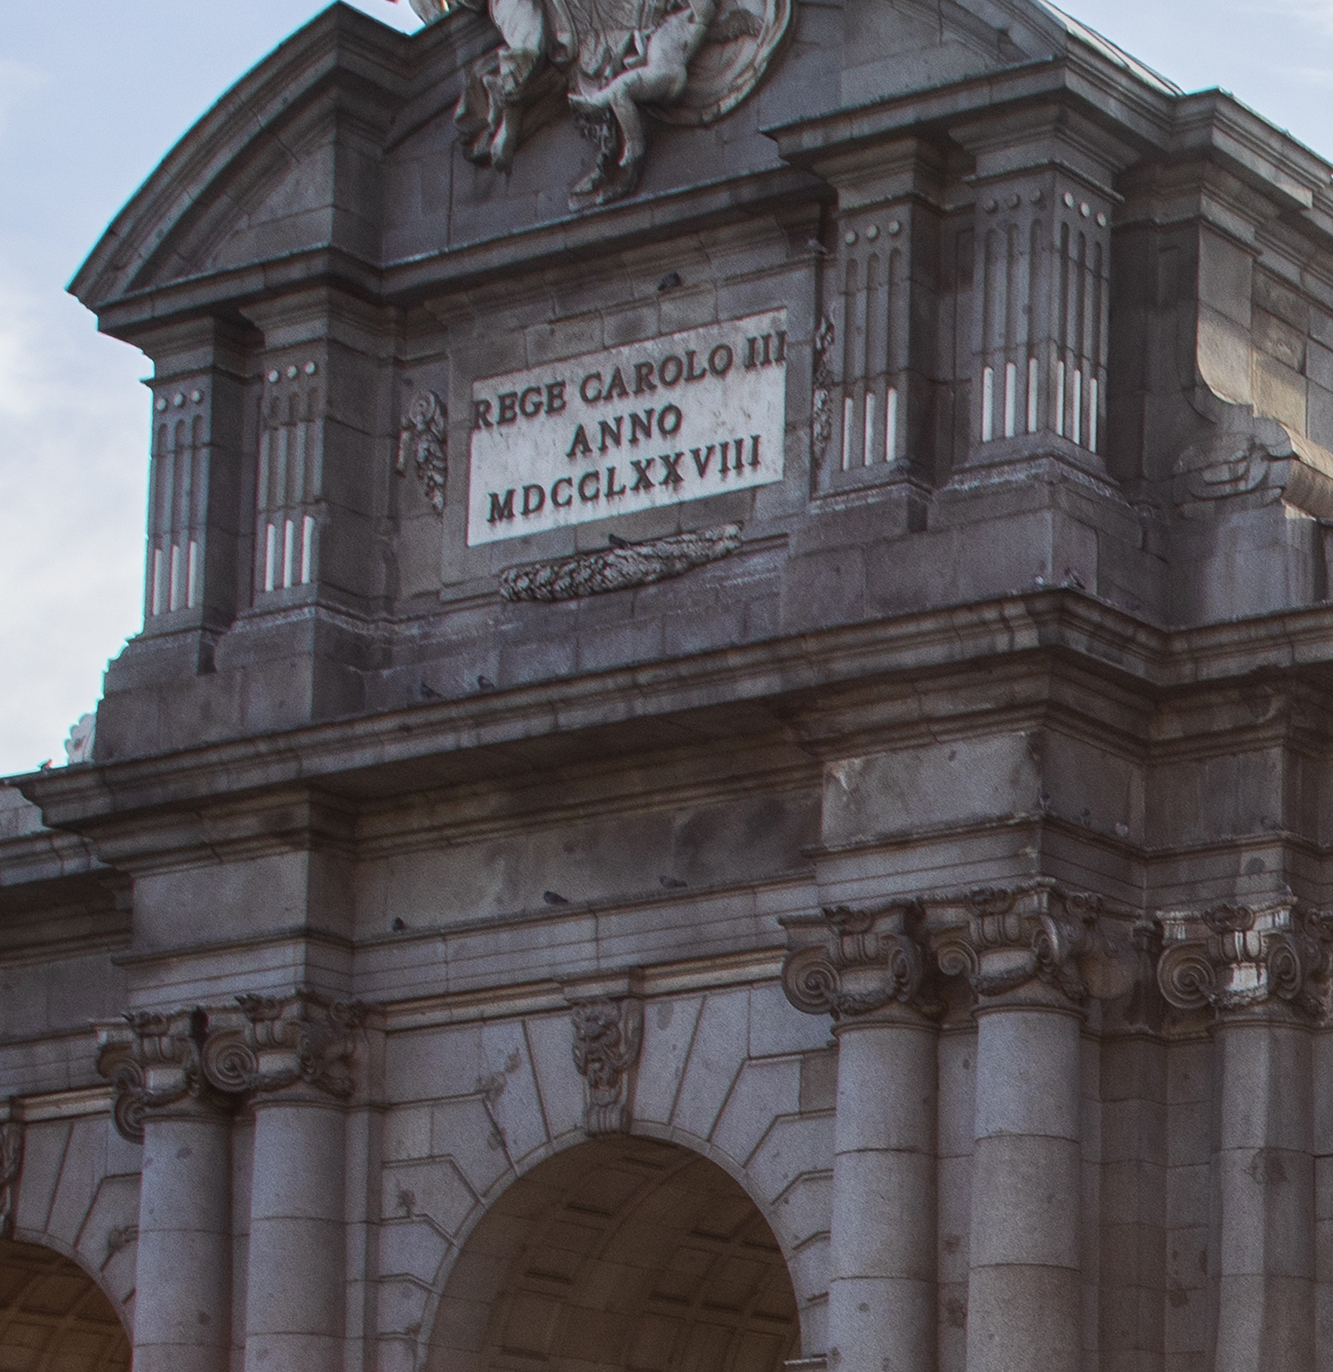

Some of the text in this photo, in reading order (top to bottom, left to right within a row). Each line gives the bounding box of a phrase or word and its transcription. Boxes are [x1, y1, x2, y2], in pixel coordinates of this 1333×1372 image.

[473, 330, 788, 429] REGE CAROLO III
[565, 403, 683, 458] ANNO
[487, 434, 762, 523] MDCCLXXVIII
